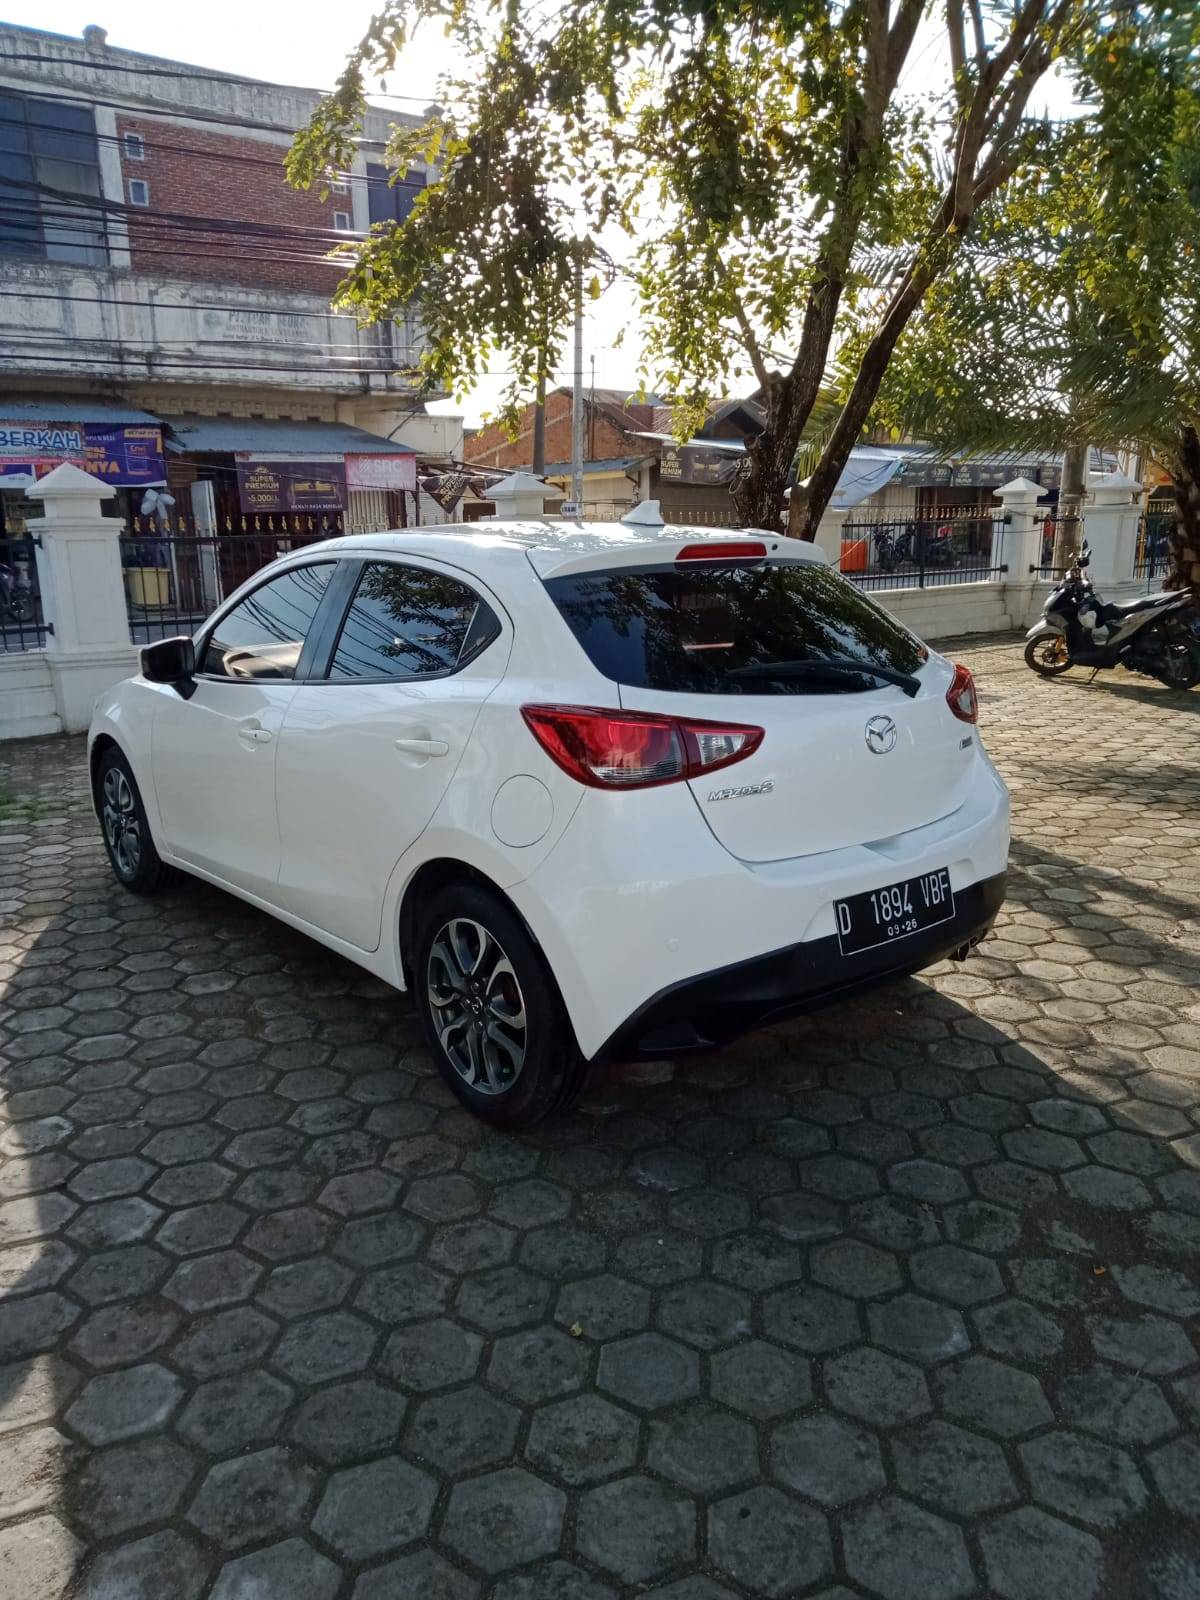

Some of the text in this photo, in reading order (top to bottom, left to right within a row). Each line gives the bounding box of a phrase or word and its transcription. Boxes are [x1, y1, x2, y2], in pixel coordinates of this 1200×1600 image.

[0, 431, 79, 449] BERKAH
[374, 460, 403, 472] SRC
[838, 871, 949, 935] D 1894 VBF
